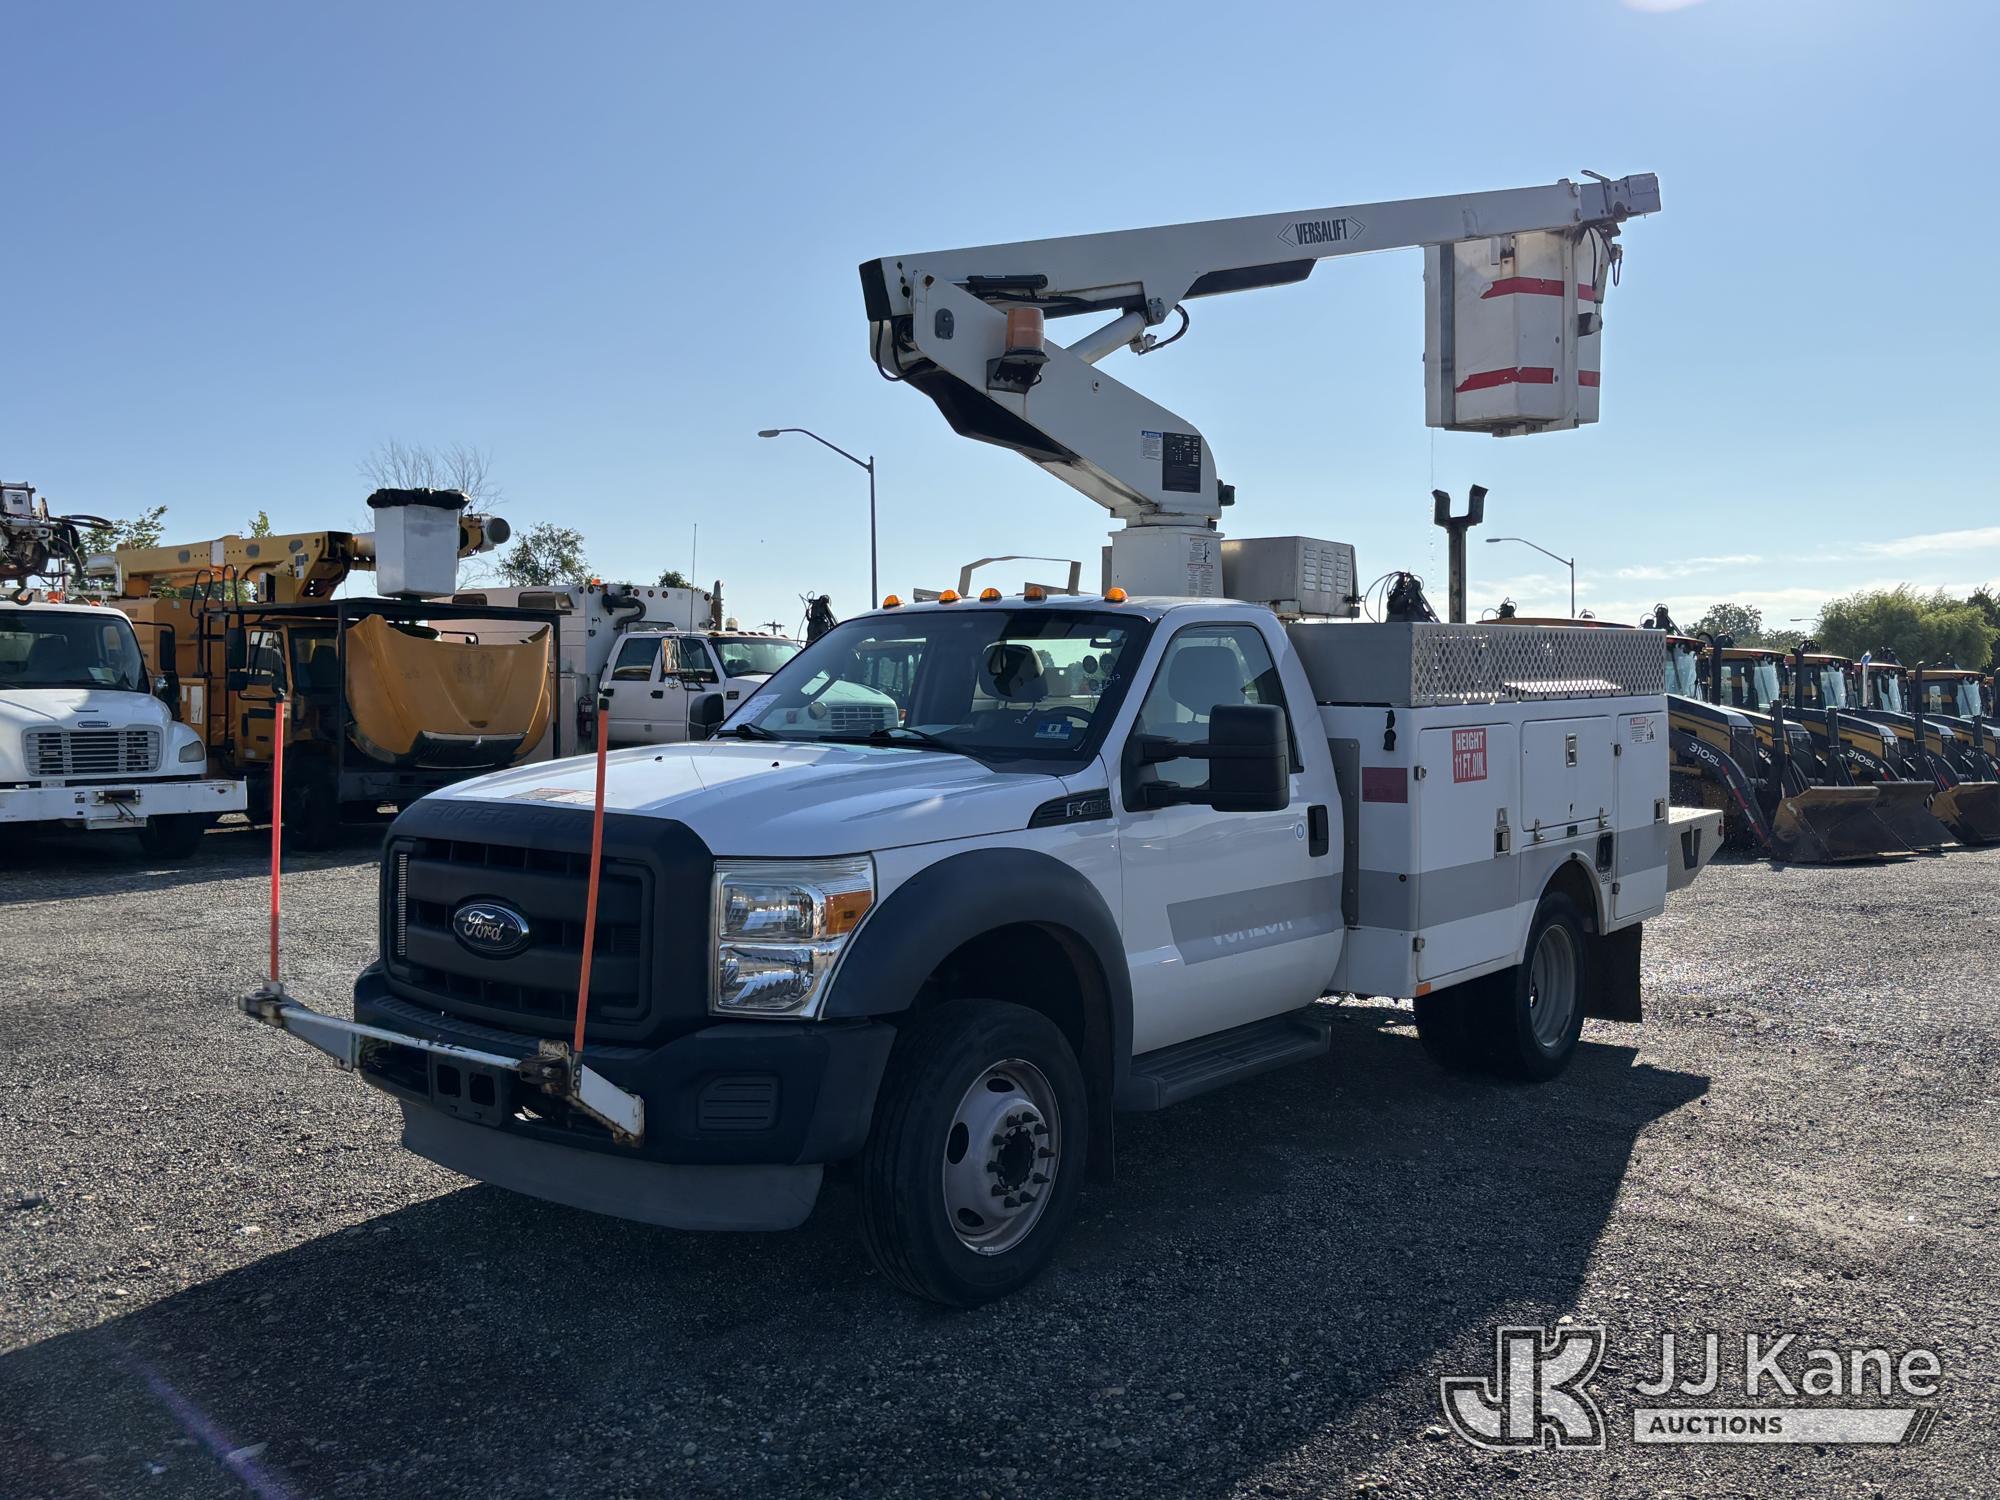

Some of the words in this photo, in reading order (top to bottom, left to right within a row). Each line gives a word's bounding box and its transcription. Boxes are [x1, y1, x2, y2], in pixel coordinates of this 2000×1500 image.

[1295, 218, 1349, 245] VERSALIFT
[1455, 731, 1484, 751] HEIGHT
[1688, 742, 1720, 767] 310SL
[1846, 749, 1876, 769] 310SL
[463, 910, 505, 941] Ford
